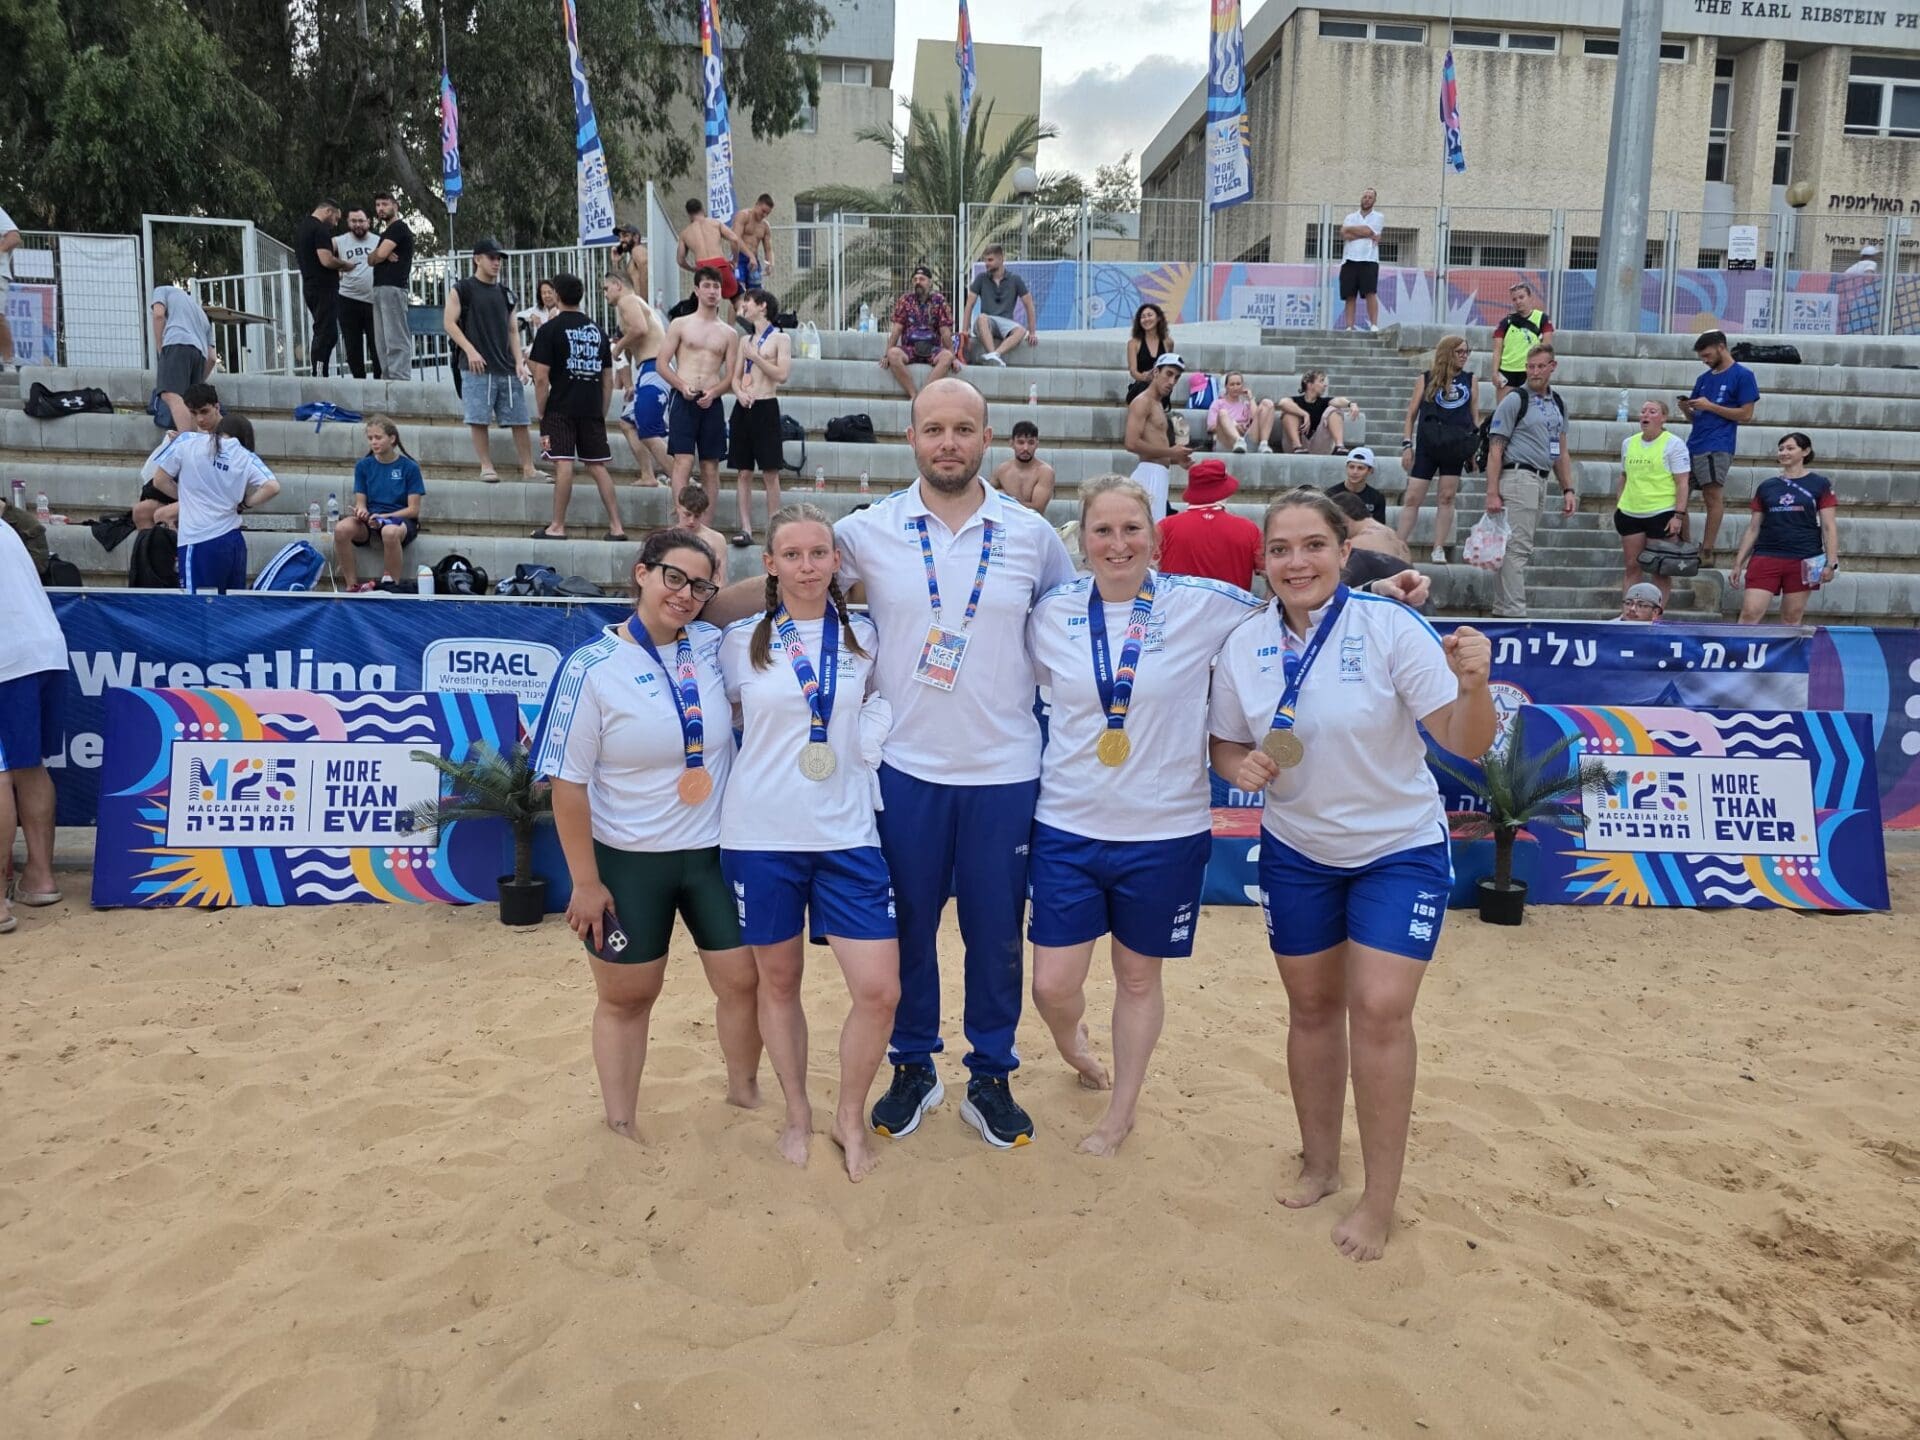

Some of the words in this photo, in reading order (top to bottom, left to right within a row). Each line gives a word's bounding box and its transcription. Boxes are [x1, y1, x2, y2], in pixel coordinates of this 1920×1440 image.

[1694, 0, 1731, 15] THE
[1741, 2, 1792, 19] KARL
[1801, 6, 1886, 26] RIBSTEIN
[1068, 617, 1087, 626] ISR
[1257, 646, 1279, 657] ISR
[1495, 632, 1597, 667] עלית
[449, 650, 538, 677] ISRAEL
[439, 674, 489, 688] Wrestling
[491, 676, 547, 689] Federation
[634, 672, 655, 685] ISR
[189, 757, 296, 801] M25
[326, 760, 382, 783] MORE
[1597, 770, 1688, 811] M25
[1712, 773, 1760, 795] MORE
[325, 785, 397, 807] THAN
[187, 805, 260, 813] MACCABIAH
[266, 805, 296, 813] 2025
[1712, 796, 1777, 818] THAN
[186, 815, 294, 832] המכביה
[1598, 812, 1658, 820] MACCABIAH
[1663, 813, 1689, 821] 2025
[1599, 822, 1690, 839] המכביה
[1173, 911, 1191, 924] ISR
[1413, 902, 1436, 918] ISR
